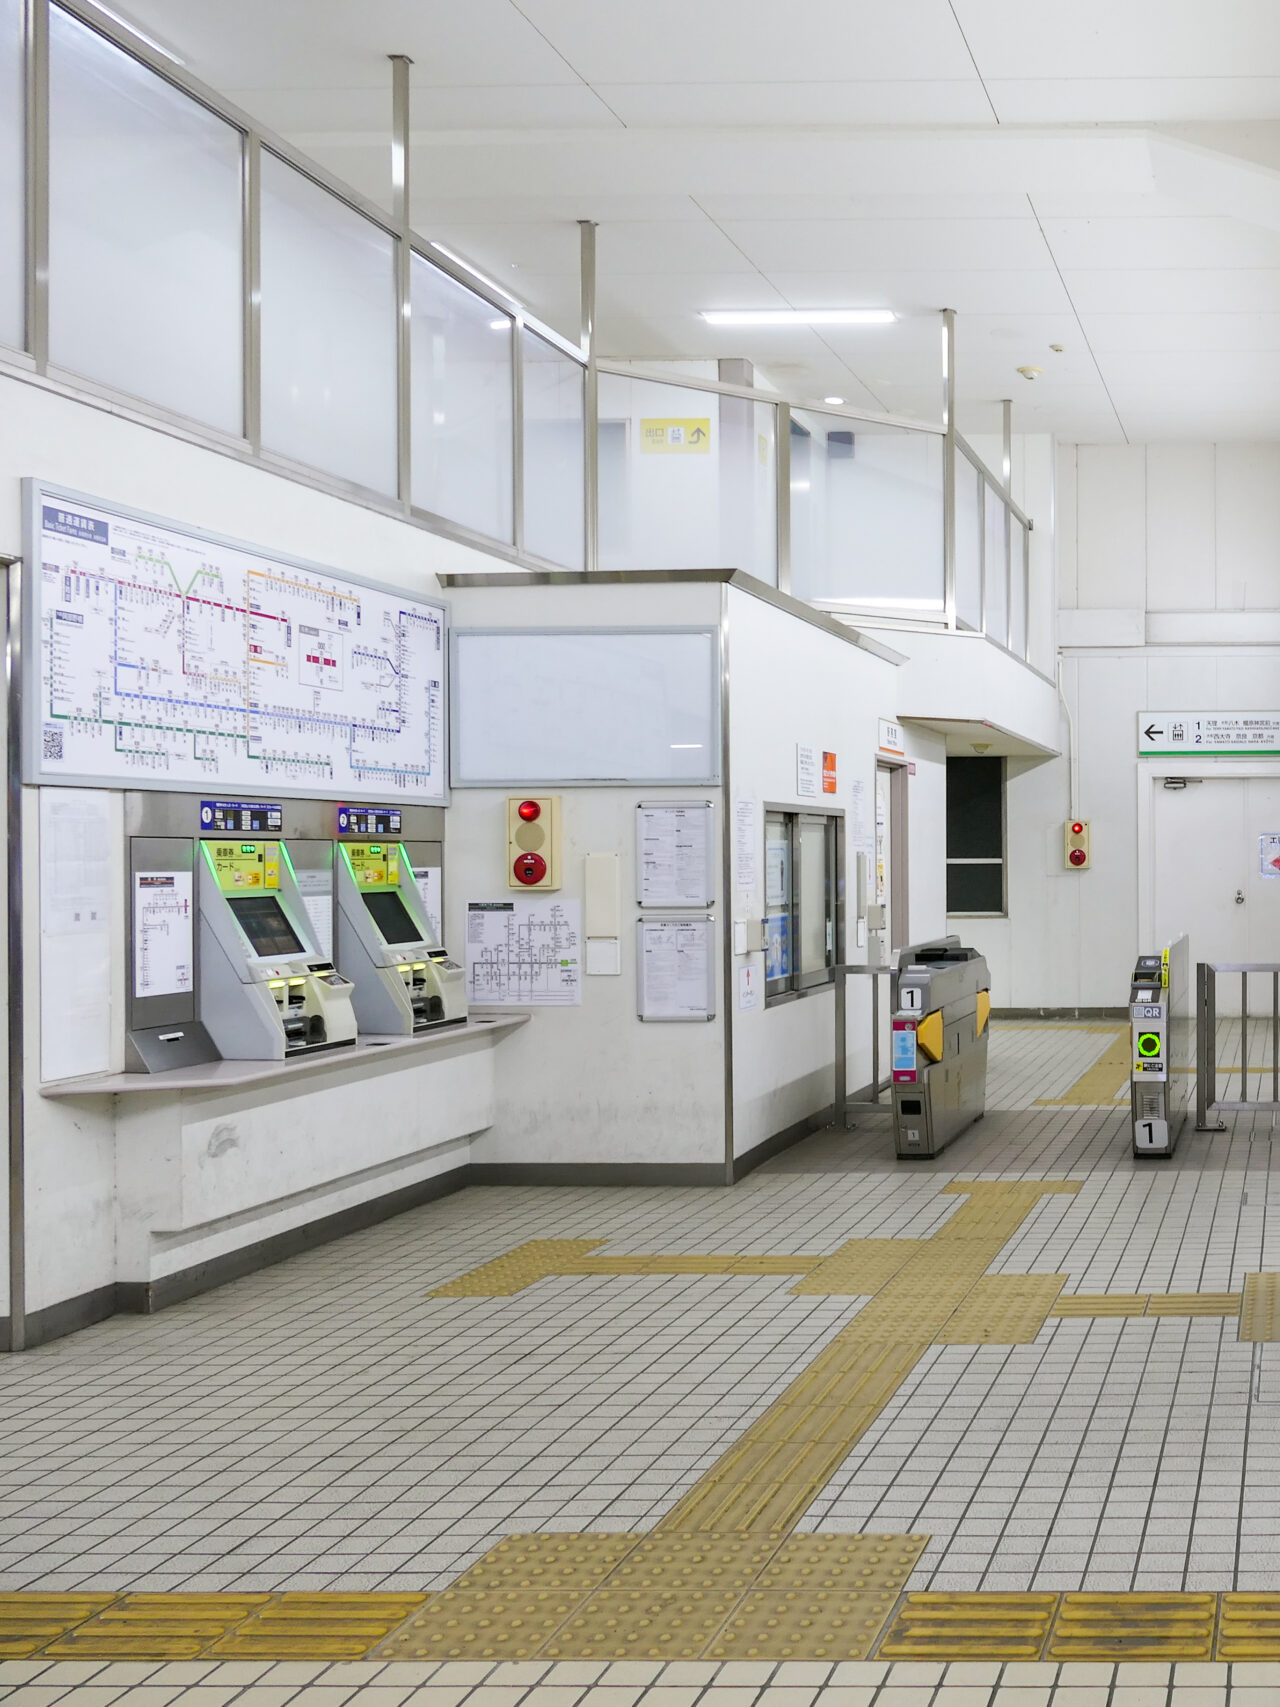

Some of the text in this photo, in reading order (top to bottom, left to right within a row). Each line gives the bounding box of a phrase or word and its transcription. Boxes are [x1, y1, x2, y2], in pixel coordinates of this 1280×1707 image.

[646, 428, 664, 437] 出口
[1195, 721, 1201, 730] 1
[1195, 735, 1202, 744] 2
[217, 862, 234, 871] カード
[906, 990, 915, 1008] 1
[1144, 1007, 1160, 1017] QR
[1142, 1122, 1153, 1144] 1
